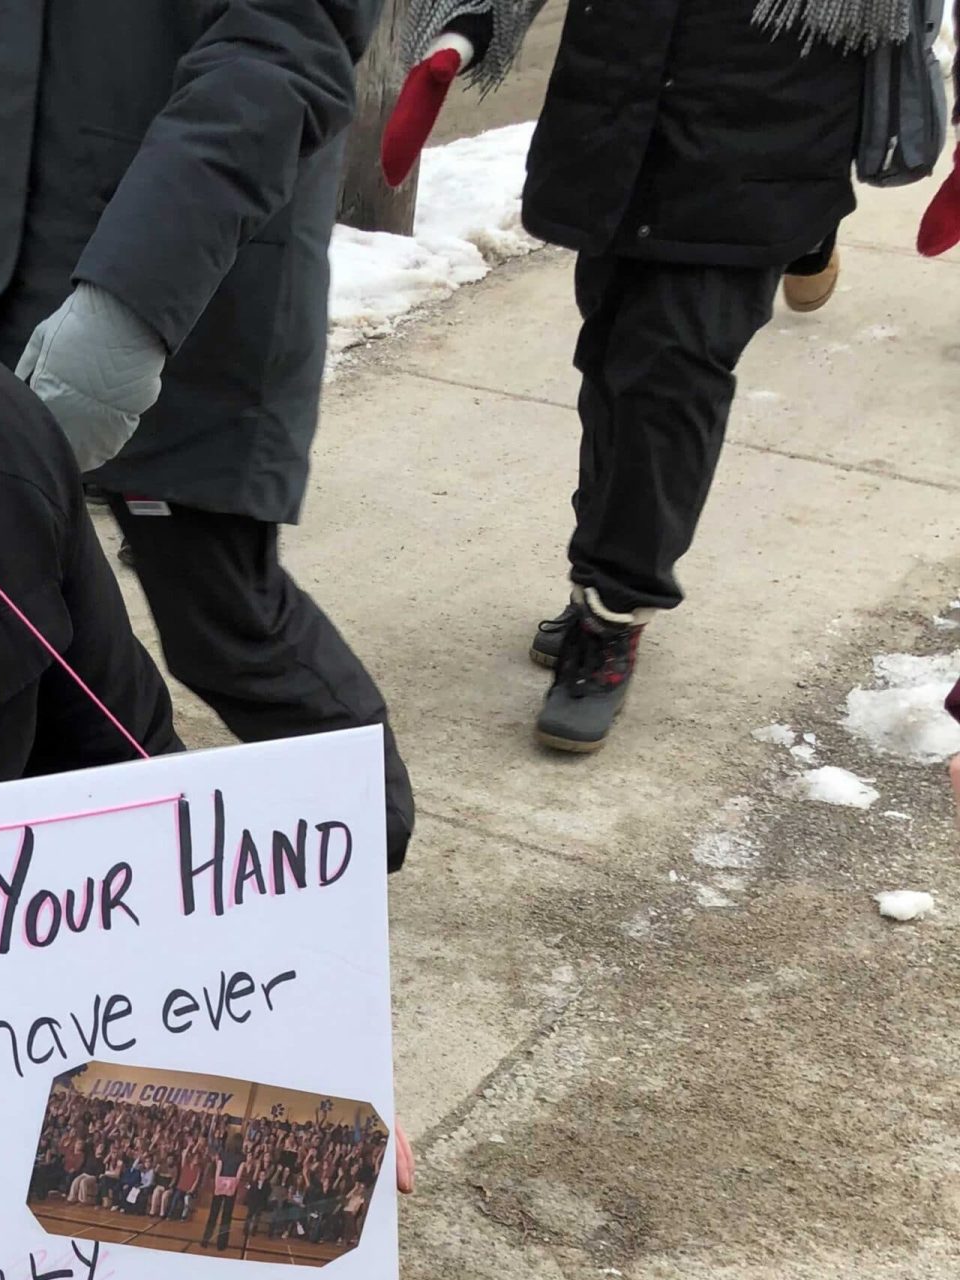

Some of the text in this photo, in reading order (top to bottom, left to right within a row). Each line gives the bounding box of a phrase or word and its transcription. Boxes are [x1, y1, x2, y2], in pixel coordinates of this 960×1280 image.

[175, 789, 353, 917] HAND
[161, 969, 297, 1034] ever
[90, 1078, 234, 1109] LION COUNTRY
